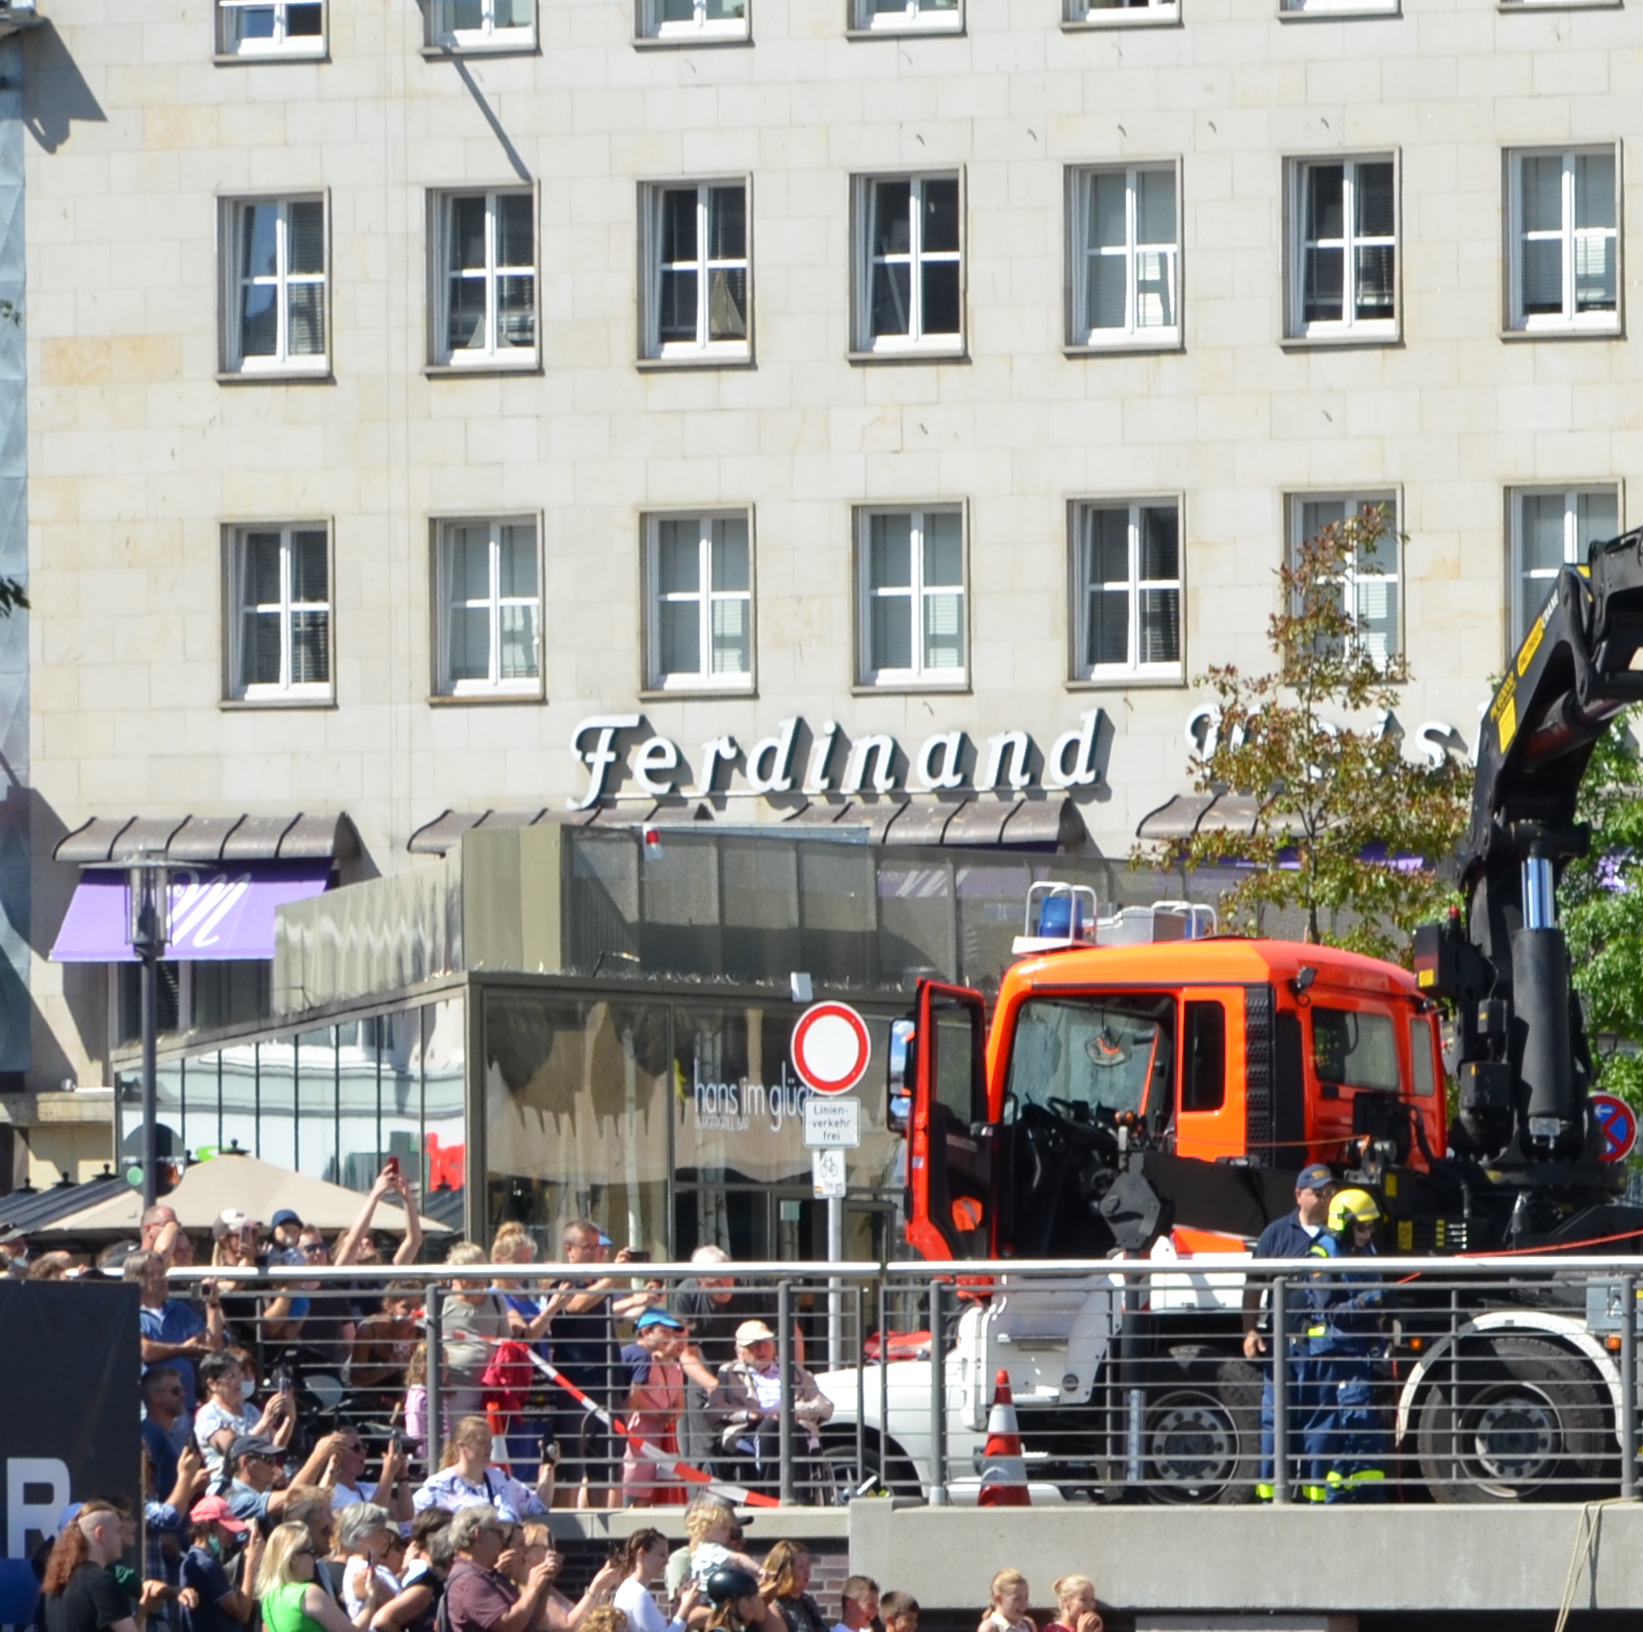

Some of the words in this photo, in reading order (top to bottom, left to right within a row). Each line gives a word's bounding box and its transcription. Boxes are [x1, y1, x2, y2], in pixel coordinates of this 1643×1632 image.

[566, 707, 1104, 810] Ferdinand
[693, 1057, 740, 1115] hans
[742, 1076, 765, 1115] im
[813, 1104, 849, 1116] Linien-
[811, 1118, 851, 1129] verkehr
[823, 1131, 840, 1142] frei
